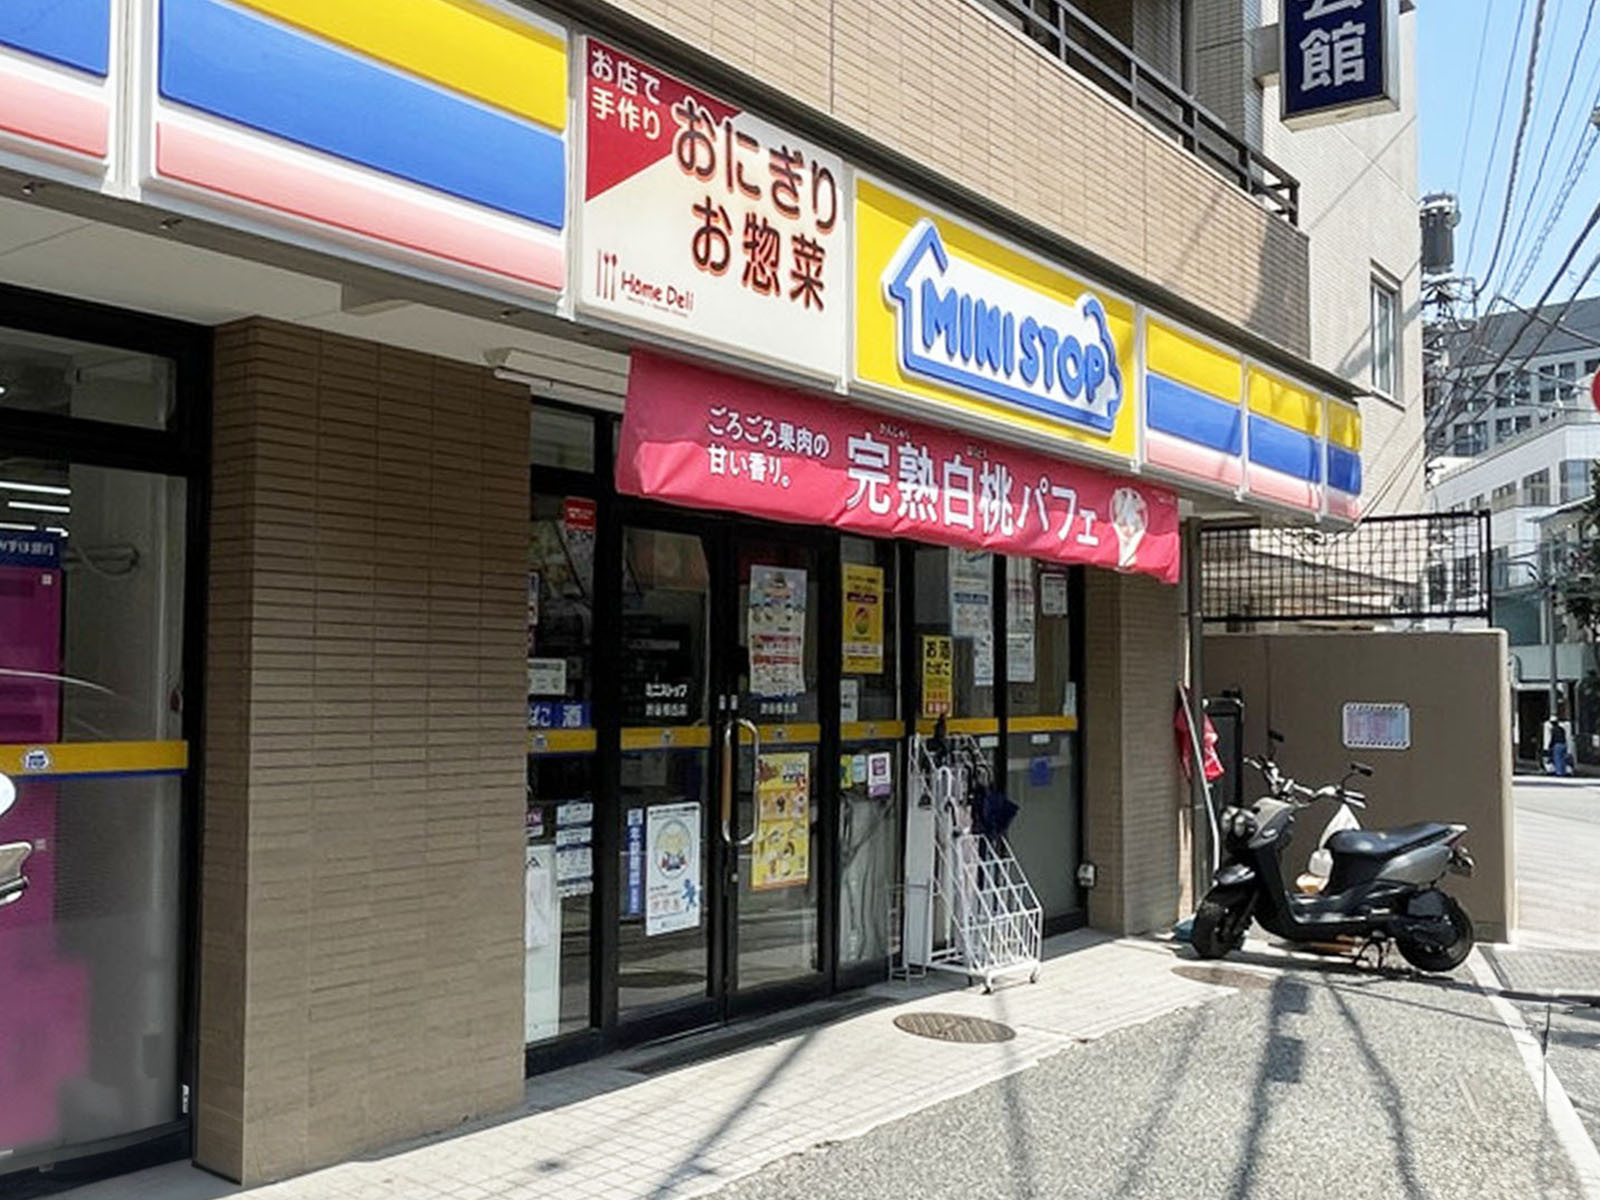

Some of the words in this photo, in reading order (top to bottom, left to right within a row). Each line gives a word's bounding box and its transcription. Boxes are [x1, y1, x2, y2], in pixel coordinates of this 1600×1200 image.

[592, 50, 660, 105] お店で
[592, 86, 661, 140] 手作り
[673, 98, 838, 234] おにぎり
[691, 195, 826, 312] お惣菜
[621, 271, 663, 302] Home
[666, 285, 695, 311] Deli
[708, 406, 830, 458] ごろごろ果肉の
[708, 443, 791, 488] 甘い香り。
[846, 432, 1100, 546] 完熟白桃パフェ
